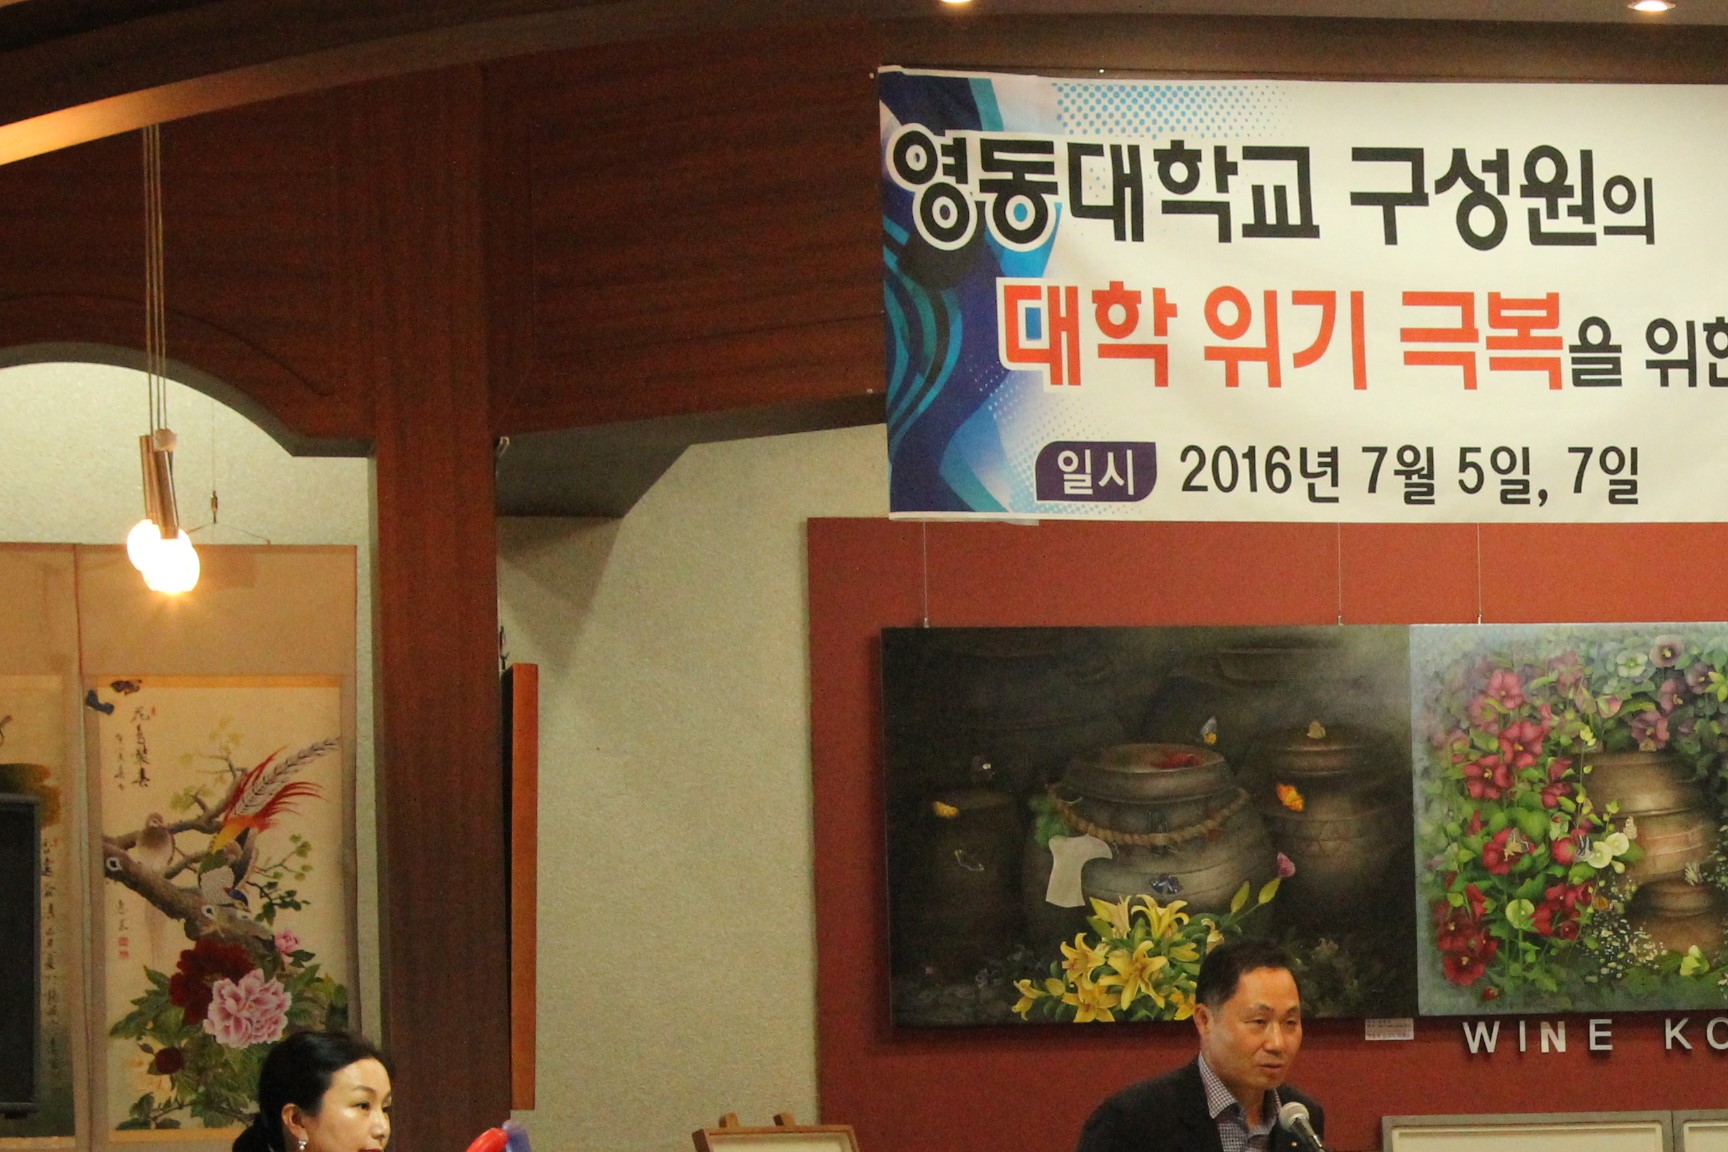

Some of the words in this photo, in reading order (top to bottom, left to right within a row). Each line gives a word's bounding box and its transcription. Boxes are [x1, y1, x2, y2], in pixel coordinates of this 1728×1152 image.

[893, 129, 1320, 245] 영동대학교
[1350, 144, 1655, 251] 구성원의
[1003, 280, 1178, 388] 대학
[1204, 285, 1367, 390] 위기
[1400, 290, 1623, 390] 극복을
[1057, 448, 1136, 496] 일시
[1180, 445, 1340, 504] 2016년
[1361, 444, 1436, 505] 7월
[1458, 445, 1548, 508] 5일,
[1568, 445, 1639, 505] 7일
[1462, 1018, 1613, 1054] WINE
